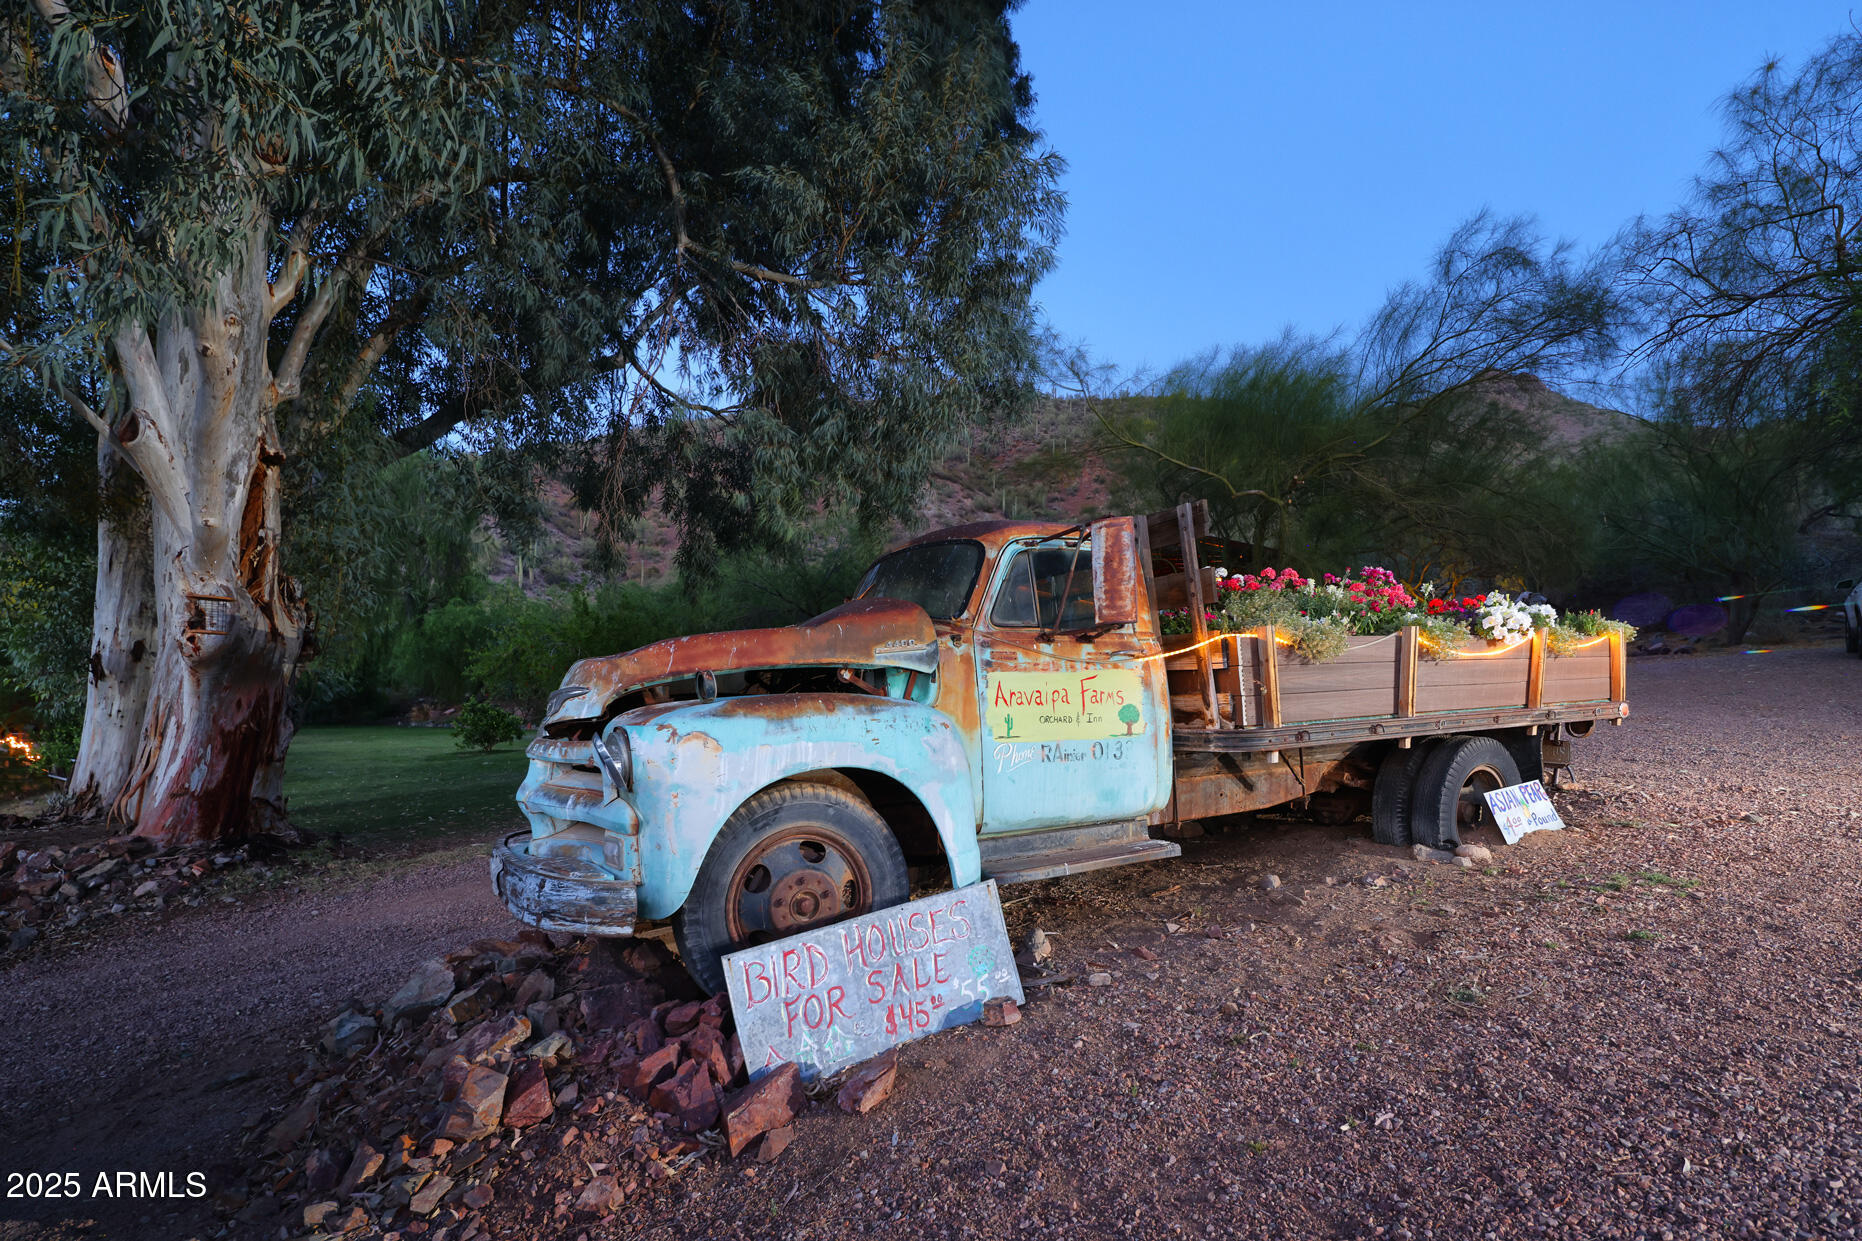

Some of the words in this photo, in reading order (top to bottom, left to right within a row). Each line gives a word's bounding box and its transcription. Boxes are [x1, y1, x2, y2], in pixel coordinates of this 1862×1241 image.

[995, 680, 1070, 713] Aravaipa
[1039, 715, 1073, 724] ORCHARD
[1086, 712, 1103, 723] Inn
[993, 742, 1036, 774] Phone
[1489, 788, 1522, 815] ASIAN
[1531, 808, 1558, 826] Pound
[743, 943, 829, 1009] BIRD
[841, 900, 972, 974] HOUSES
[781, 986, 856, 1038] FOR
[866, 952, 952, 1004] SALE
